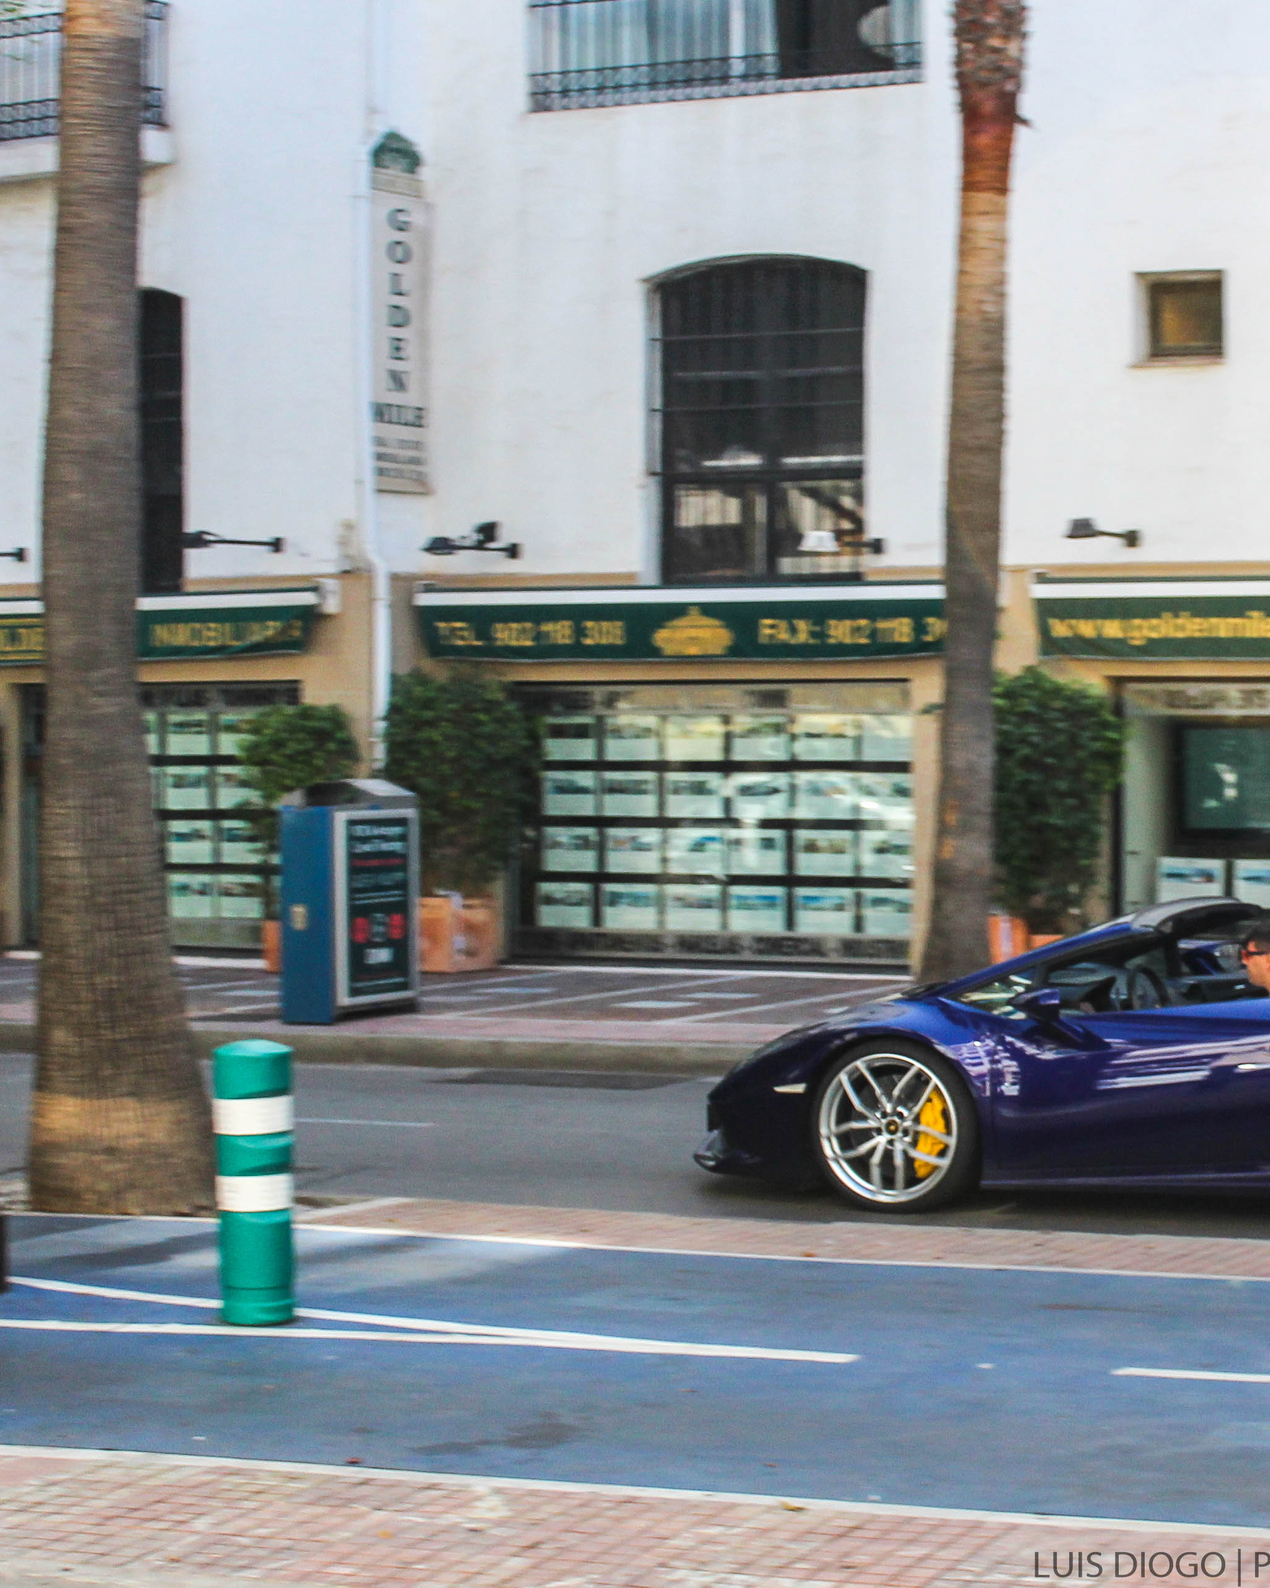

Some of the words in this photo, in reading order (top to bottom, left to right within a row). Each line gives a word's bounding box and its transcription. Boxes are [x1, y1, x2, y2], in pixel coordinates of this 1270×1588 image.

[385, 207, 413, 393] GOLDEN
[491, 621, 537, 646] 902
[824, 618, 872, 644] 902
